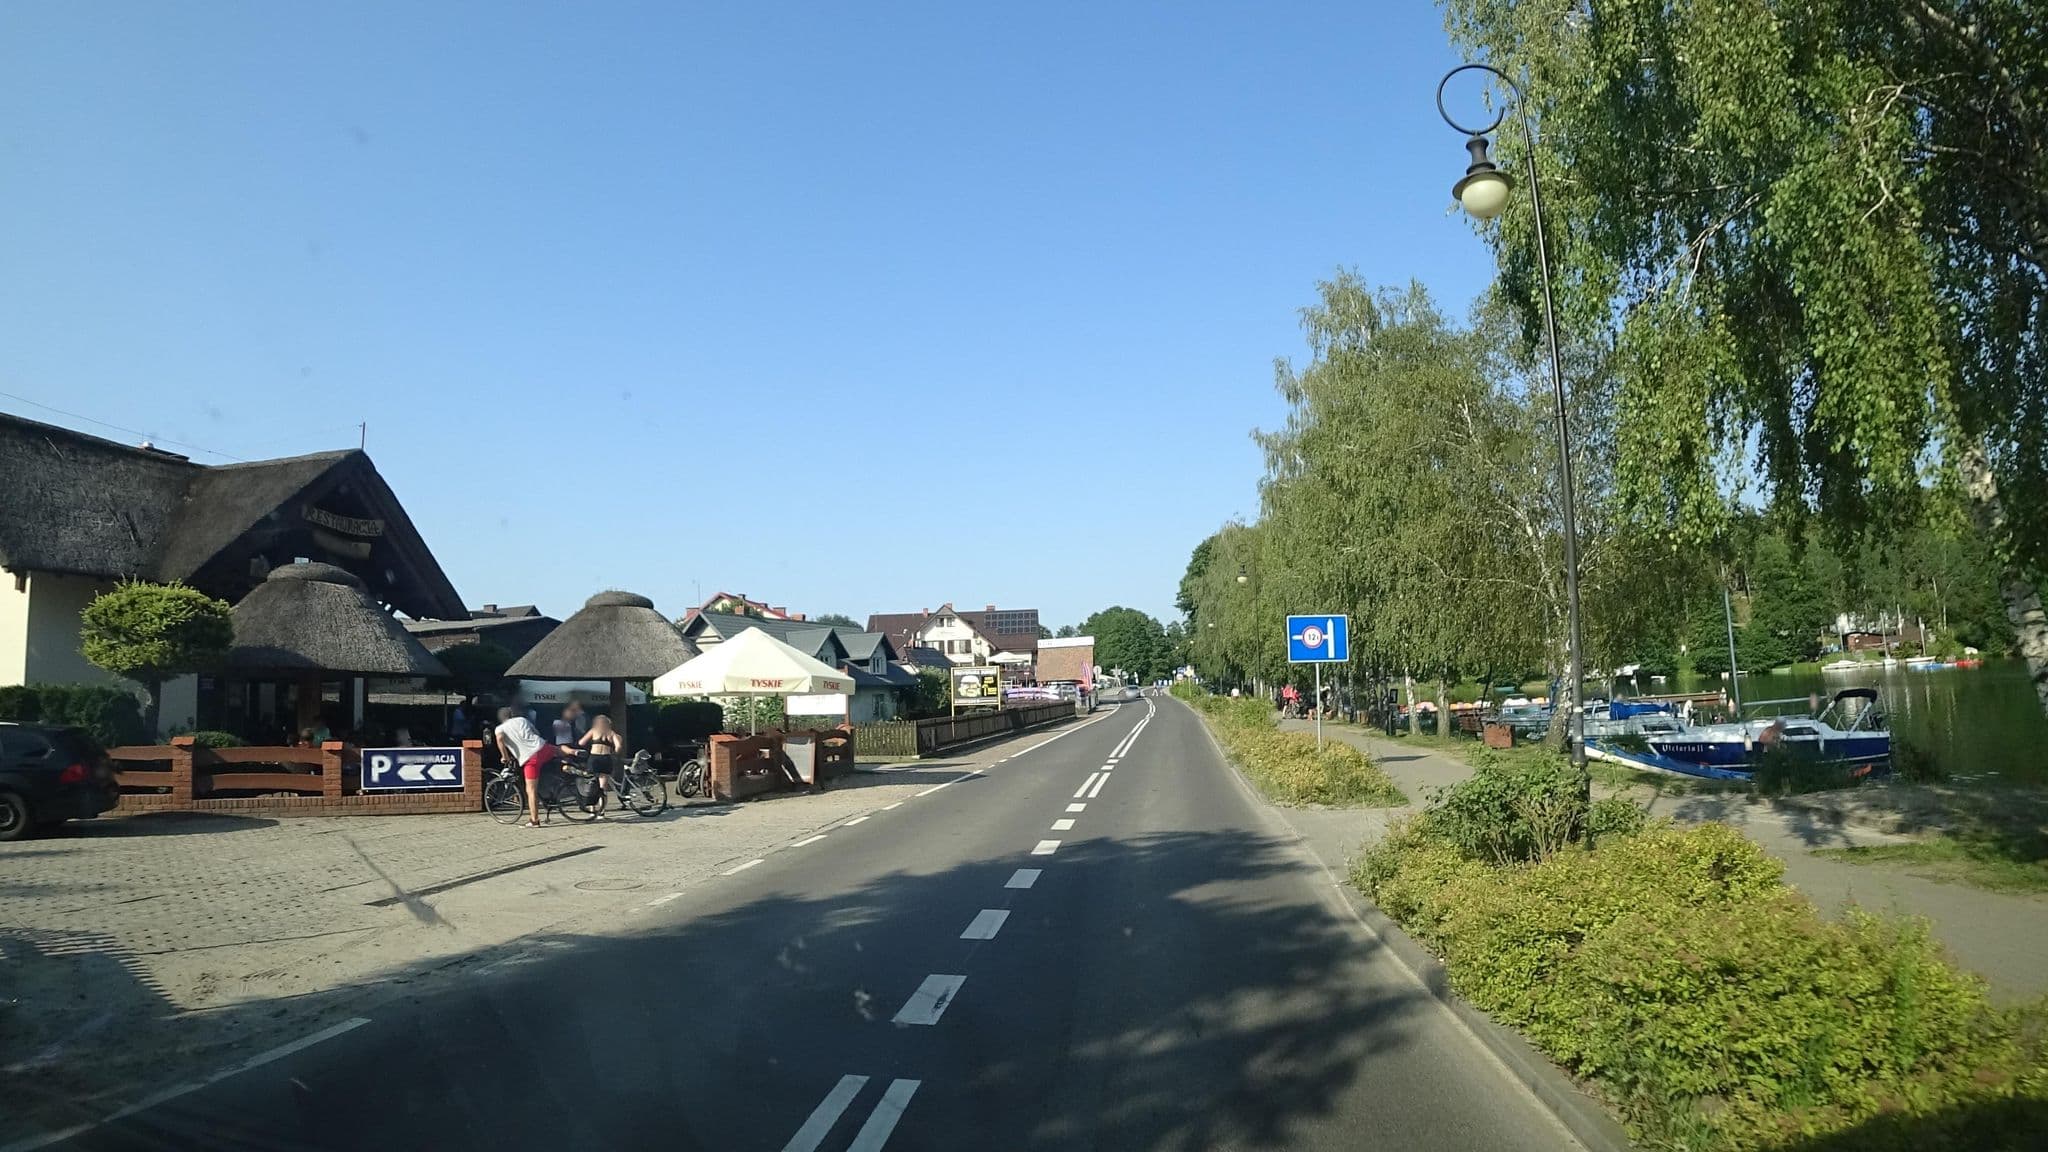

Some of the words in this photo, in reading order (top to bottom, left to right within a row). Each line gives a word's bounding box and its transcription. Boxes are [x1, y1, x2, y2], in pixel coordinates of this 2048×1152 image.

[679, 681, 703, 689] TYSKIE
[751, 679, 784, 688] TYSKIE
[823, 681, 841, 691] TYSKIE
[371, 755, 392, 783] P
